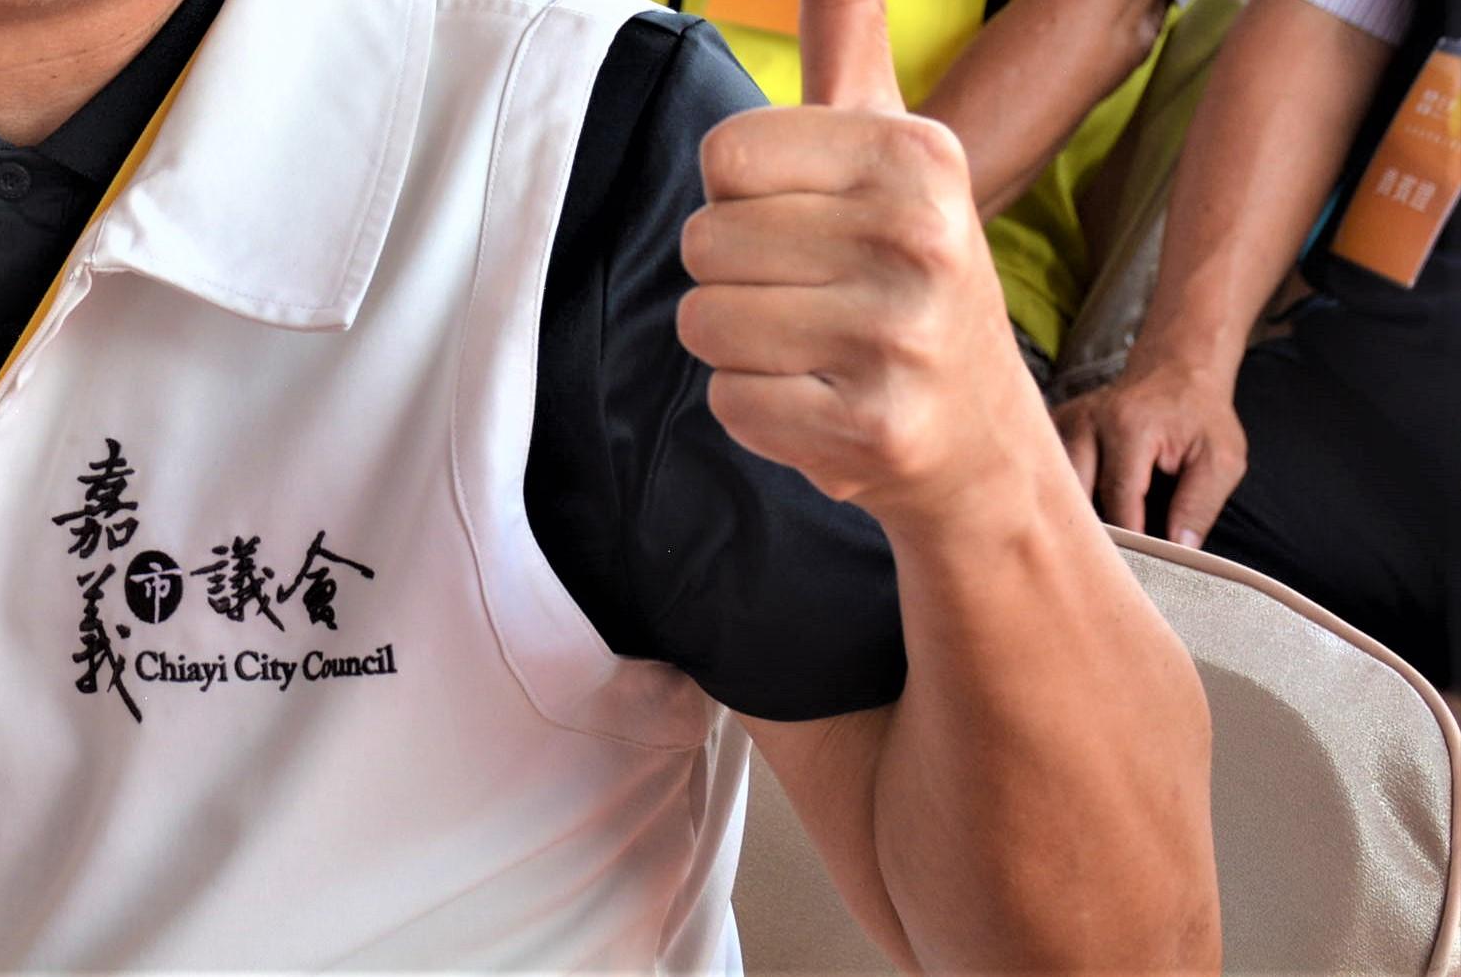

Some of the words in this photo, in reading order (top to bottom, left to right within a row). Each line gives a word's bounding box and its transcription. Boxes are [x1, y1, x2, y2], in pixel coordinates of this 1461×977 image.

[135, 650, 229, 692] Chiayi
[234, 649, 297, 692] City
[302, 643, 398, 681] Council
